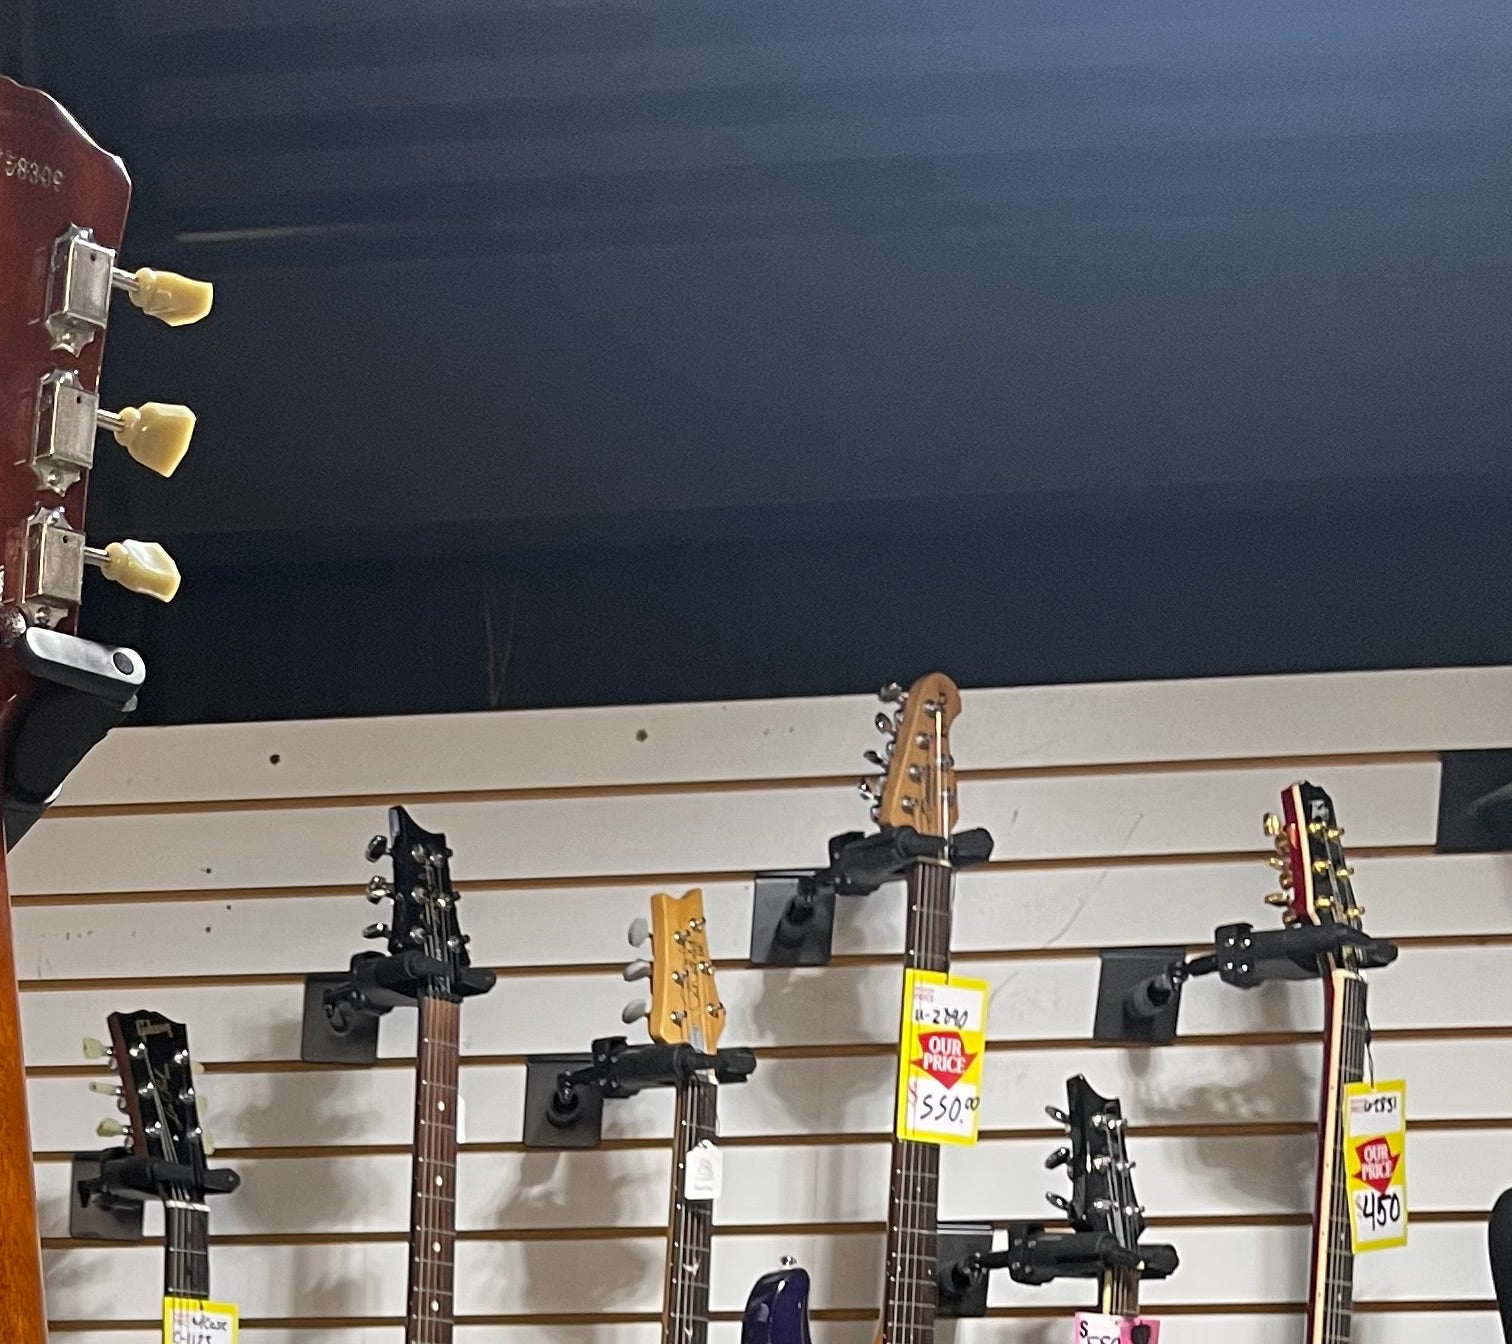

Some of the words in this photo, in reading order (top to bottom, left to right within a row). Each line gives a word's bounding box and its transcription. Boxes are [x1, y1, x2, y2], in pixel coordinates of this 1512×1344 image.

[928, 1035, 962, 1056] OUR
[923, 1053, 966, 1074] PRICE
[1364, 1144, 1389, 1163] OUR
[1362, 1161, 1393, 1181] PRICE
